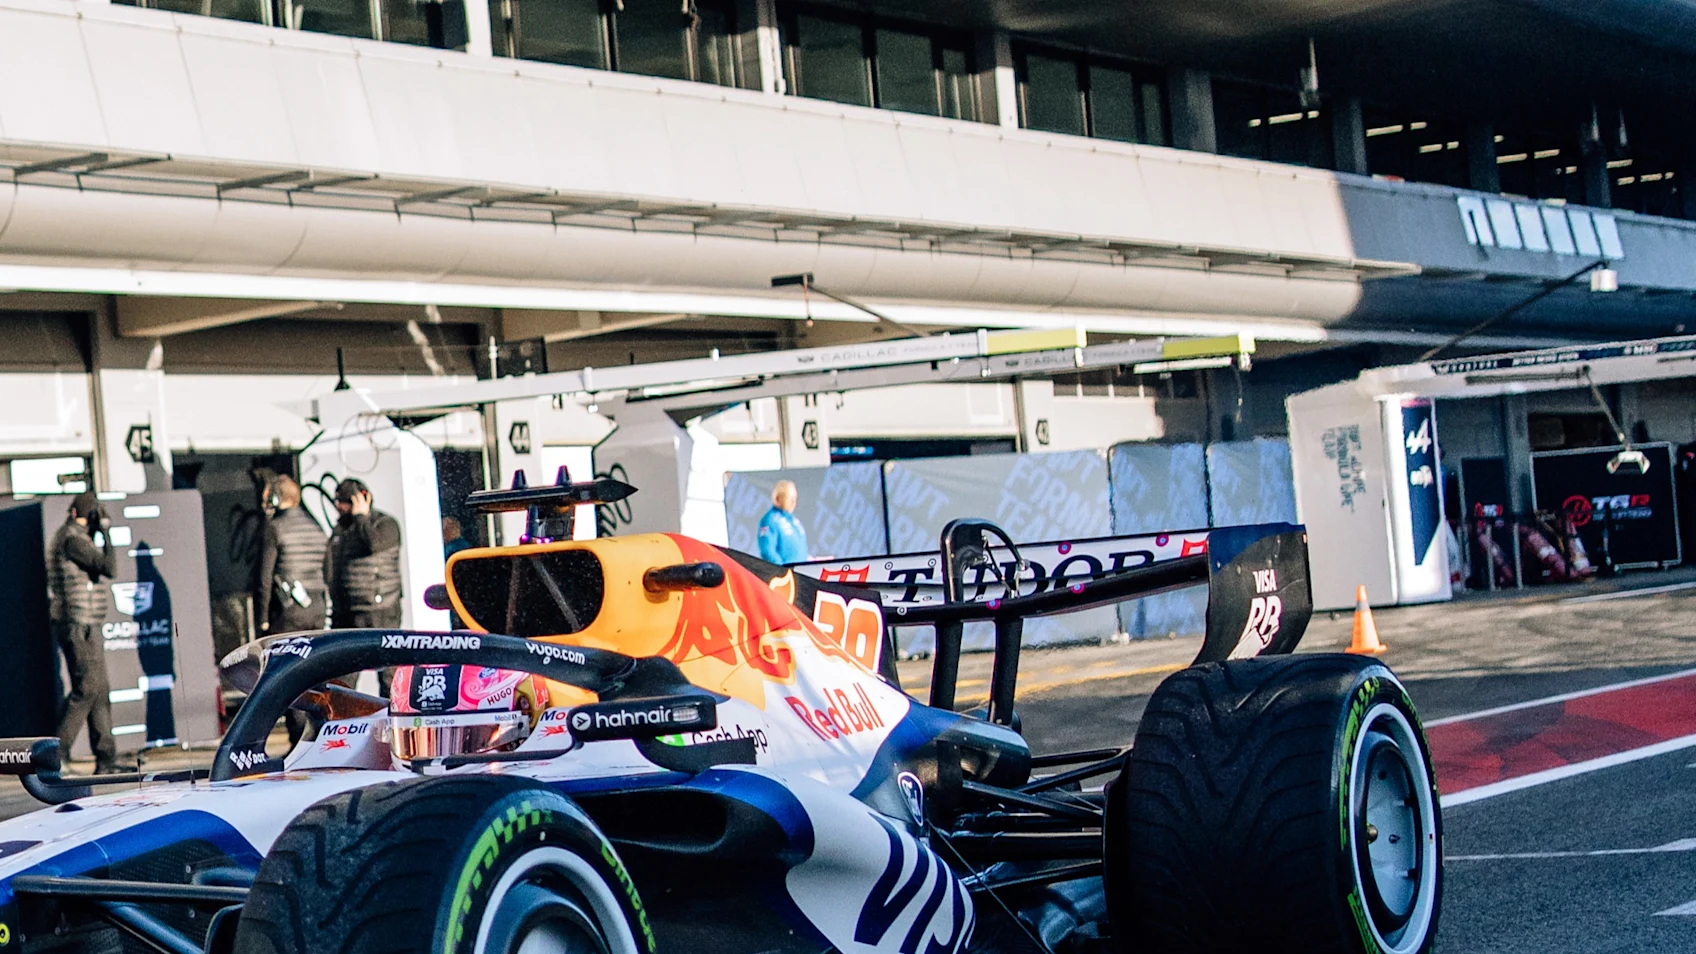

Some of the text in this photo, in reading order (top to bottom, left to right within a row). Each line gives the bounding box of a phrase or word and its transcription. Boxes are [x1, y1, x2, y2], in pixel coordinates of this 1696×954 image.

[129, 429, 152, 459] 45
[512, 425, 529, 450] 44
[1252, 569, 1278, 594] VISA
[387, 635, 481, 650] XMTRADING
[525, 642, 586, 666] yugo.com
[425, 668, 444, 676] VISA
[486, 687, 512, 706] HUGO
[442, 718, 456, 727] App
[595, 705, 672, 730] hahnair
[323, 723, 369, 736] Mobil
